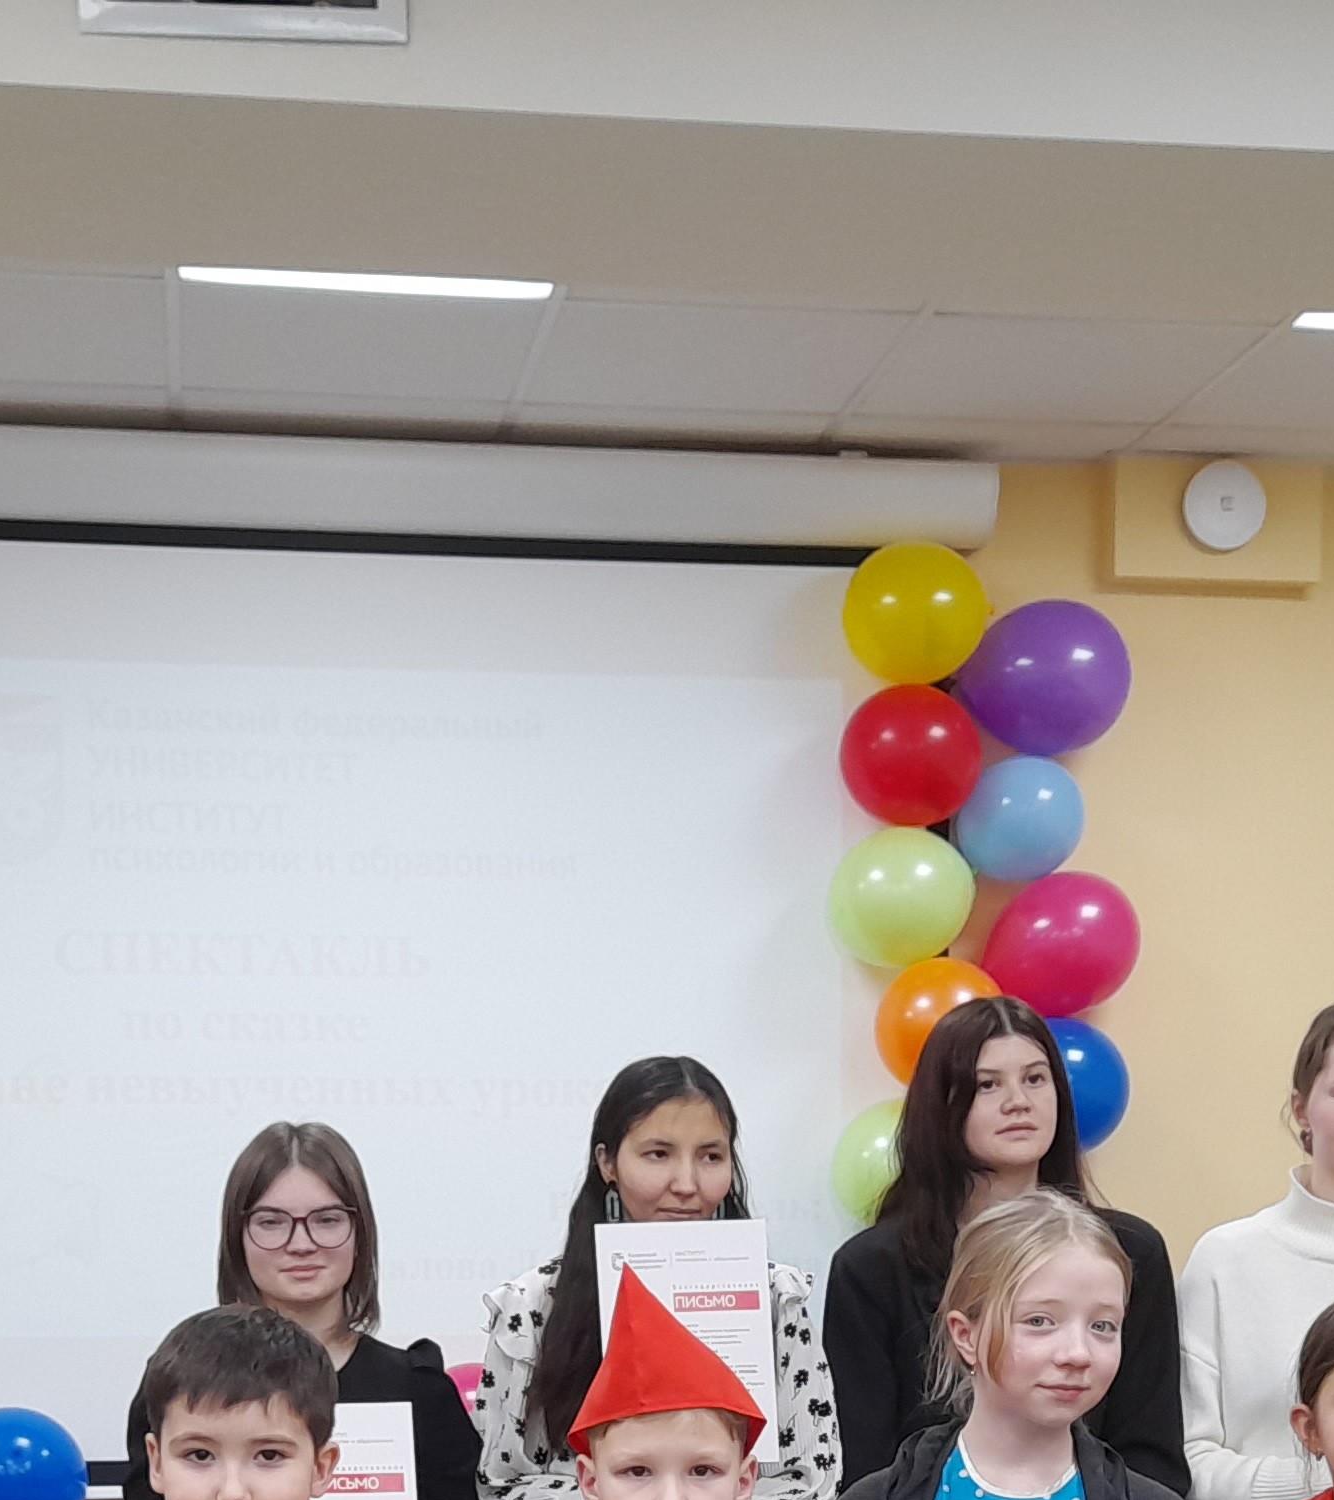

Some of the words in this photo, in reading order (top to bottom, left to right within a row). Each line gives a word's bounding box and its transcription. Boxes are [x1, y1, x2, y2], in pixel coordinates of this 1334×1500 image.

[86, 697, 280, 733] Казанский
[293, 707, 542, 743] федеральный
[87, 745, 363, 784] УНИВЕРСИТЕТ
[88, 799, 289, 836] ИНСТИТУТ
[90, 847, 302, 874] психологии
[315, 850, 336, 874] и
[348, 847, 578, 882] образования
[54, 929, 430, 978] СПЕКТАКЛЬ
[121, 1010, 184, 1042] по
[201, 1011, 372, 1043] сказке
[87, 1074, 455, 1117] невыученных
[675, 1294, 736, 1309] ПИСЬМО
[328, 1476, 379, 1491] ИСЬМО
